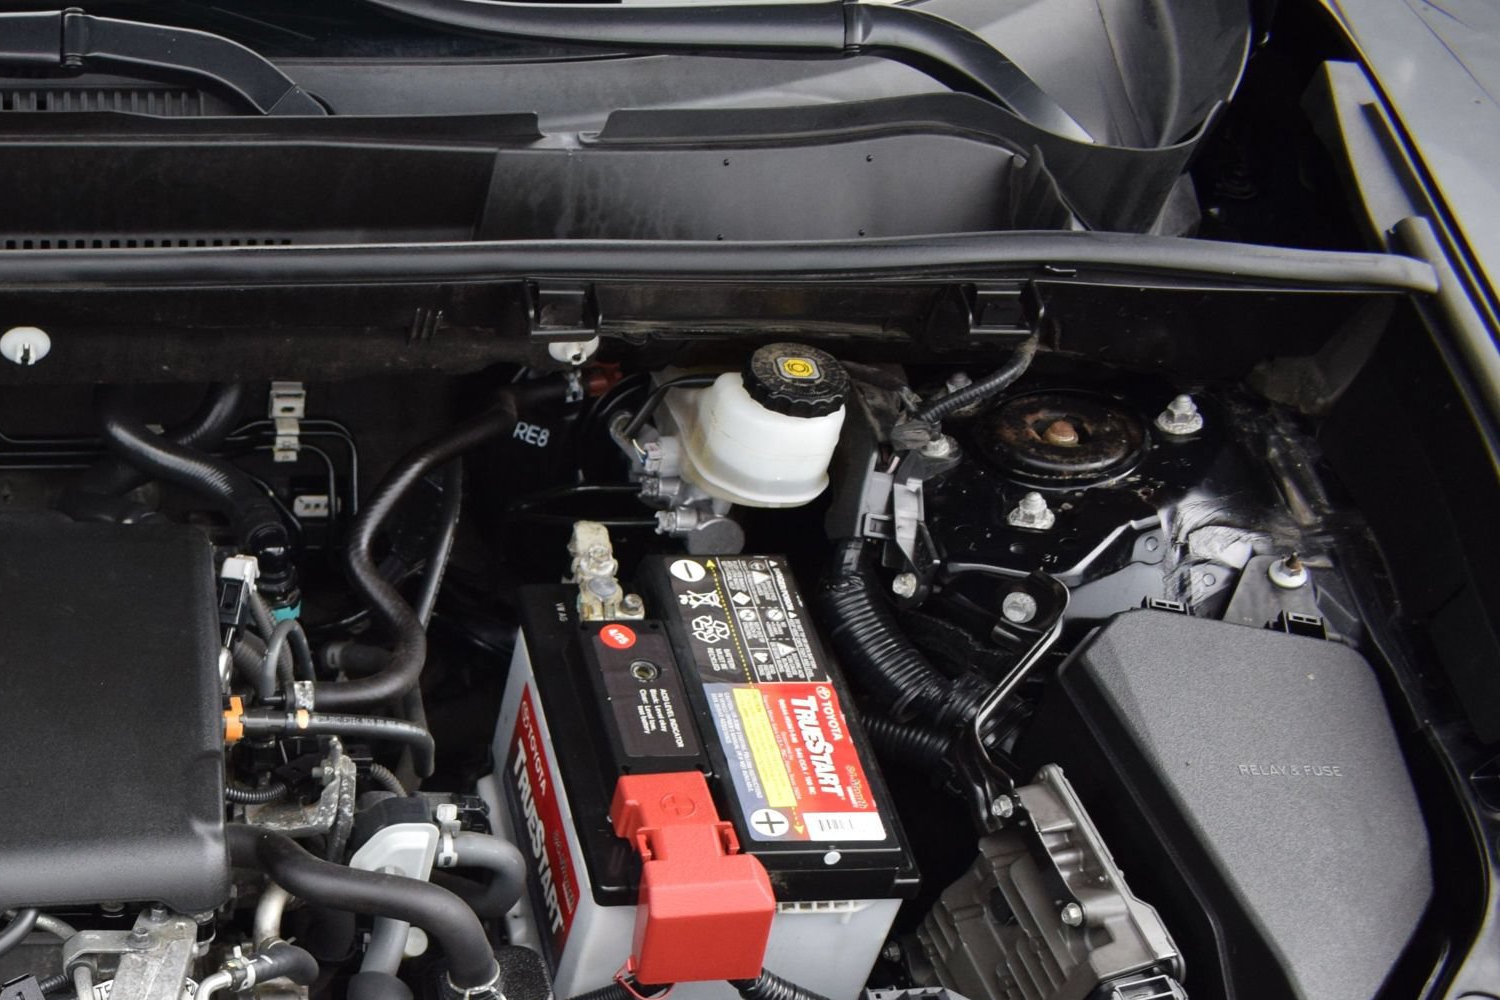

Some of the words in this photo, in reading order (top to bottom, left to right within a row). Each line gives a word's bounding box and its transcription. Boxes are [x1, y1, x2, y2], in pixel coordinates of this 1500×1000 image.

[822, 701, 845, 740] TOYOTA
[527, 730, 547, 798] TOYOTA
[1238, 764, 1286, 777] RELAY
[1304, 766, 1342, 777] FUSE
